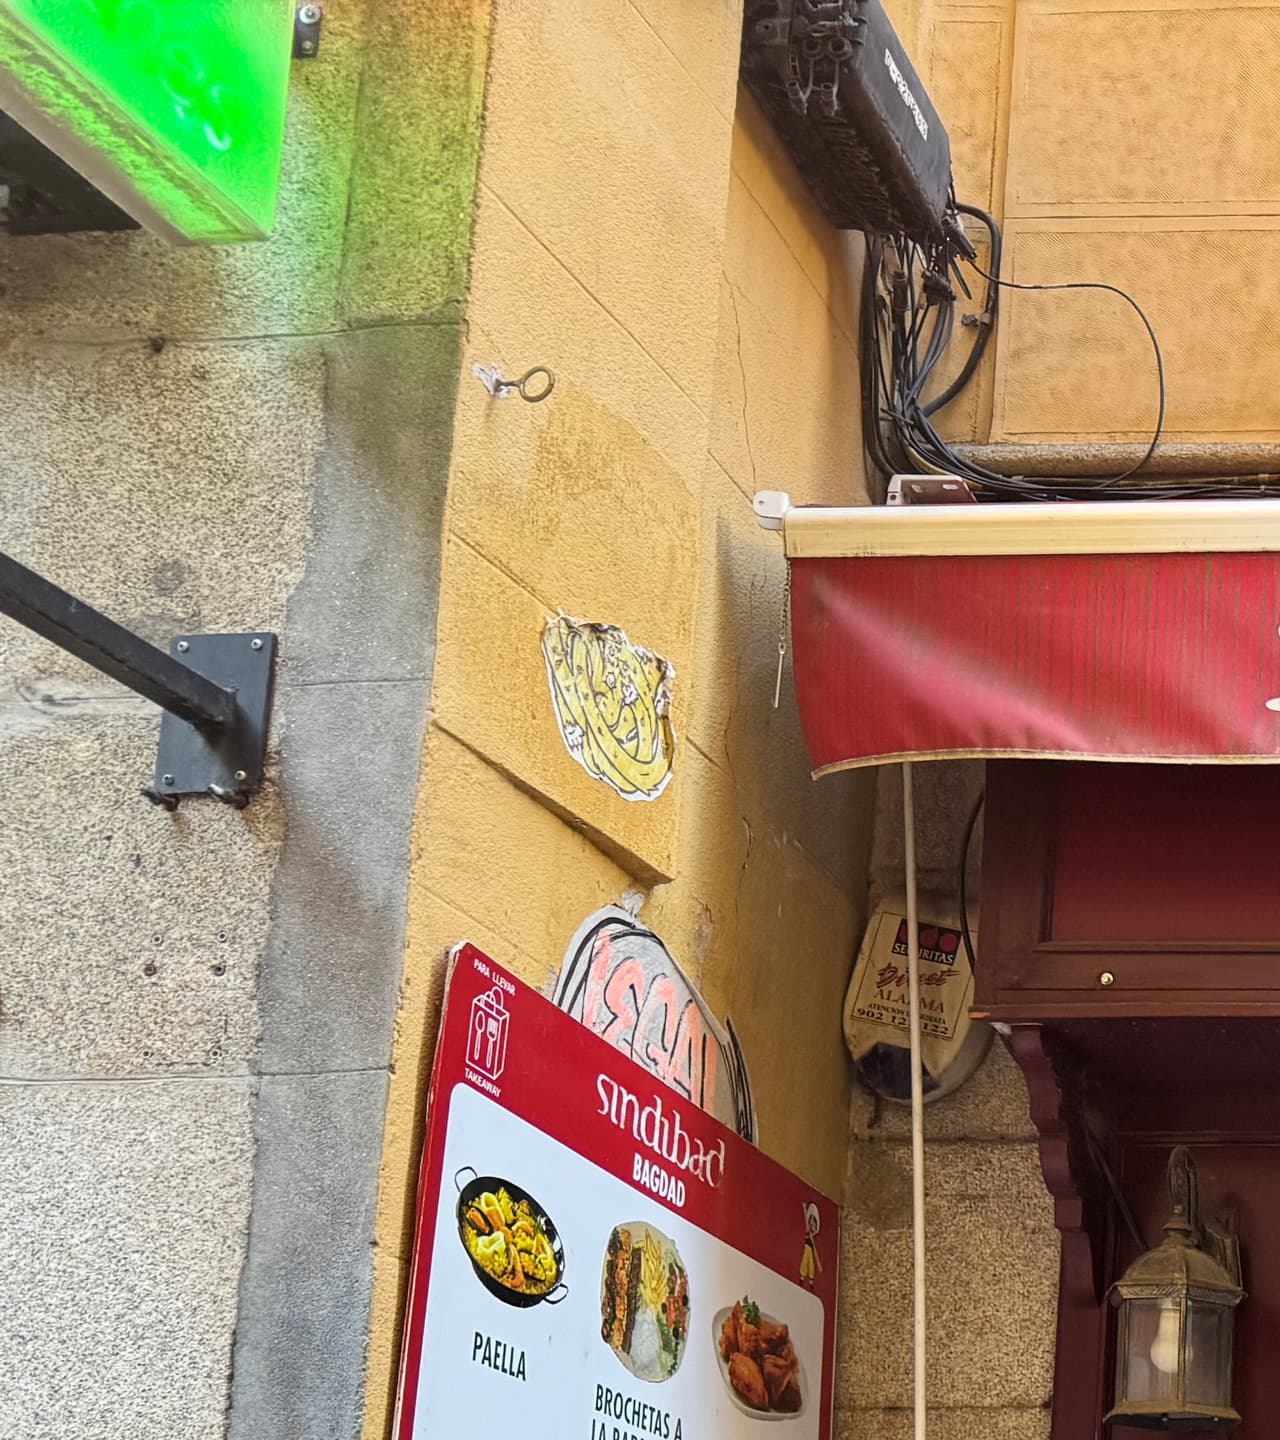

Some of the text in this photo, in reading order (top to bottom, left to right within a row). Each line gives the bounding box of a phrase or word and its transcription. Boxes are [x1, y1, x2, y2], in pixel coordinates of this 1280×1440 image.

[473, 958, 516, 996] PARA LLEVAR
[464, 1067, 501, 1097] TAKEAWAY
[633, 1152, 686, 1208] BAGDAD
[472, 1331, 527, 1381] PAELLA
[595, 1383, 670, 1440] BROCHETAS
